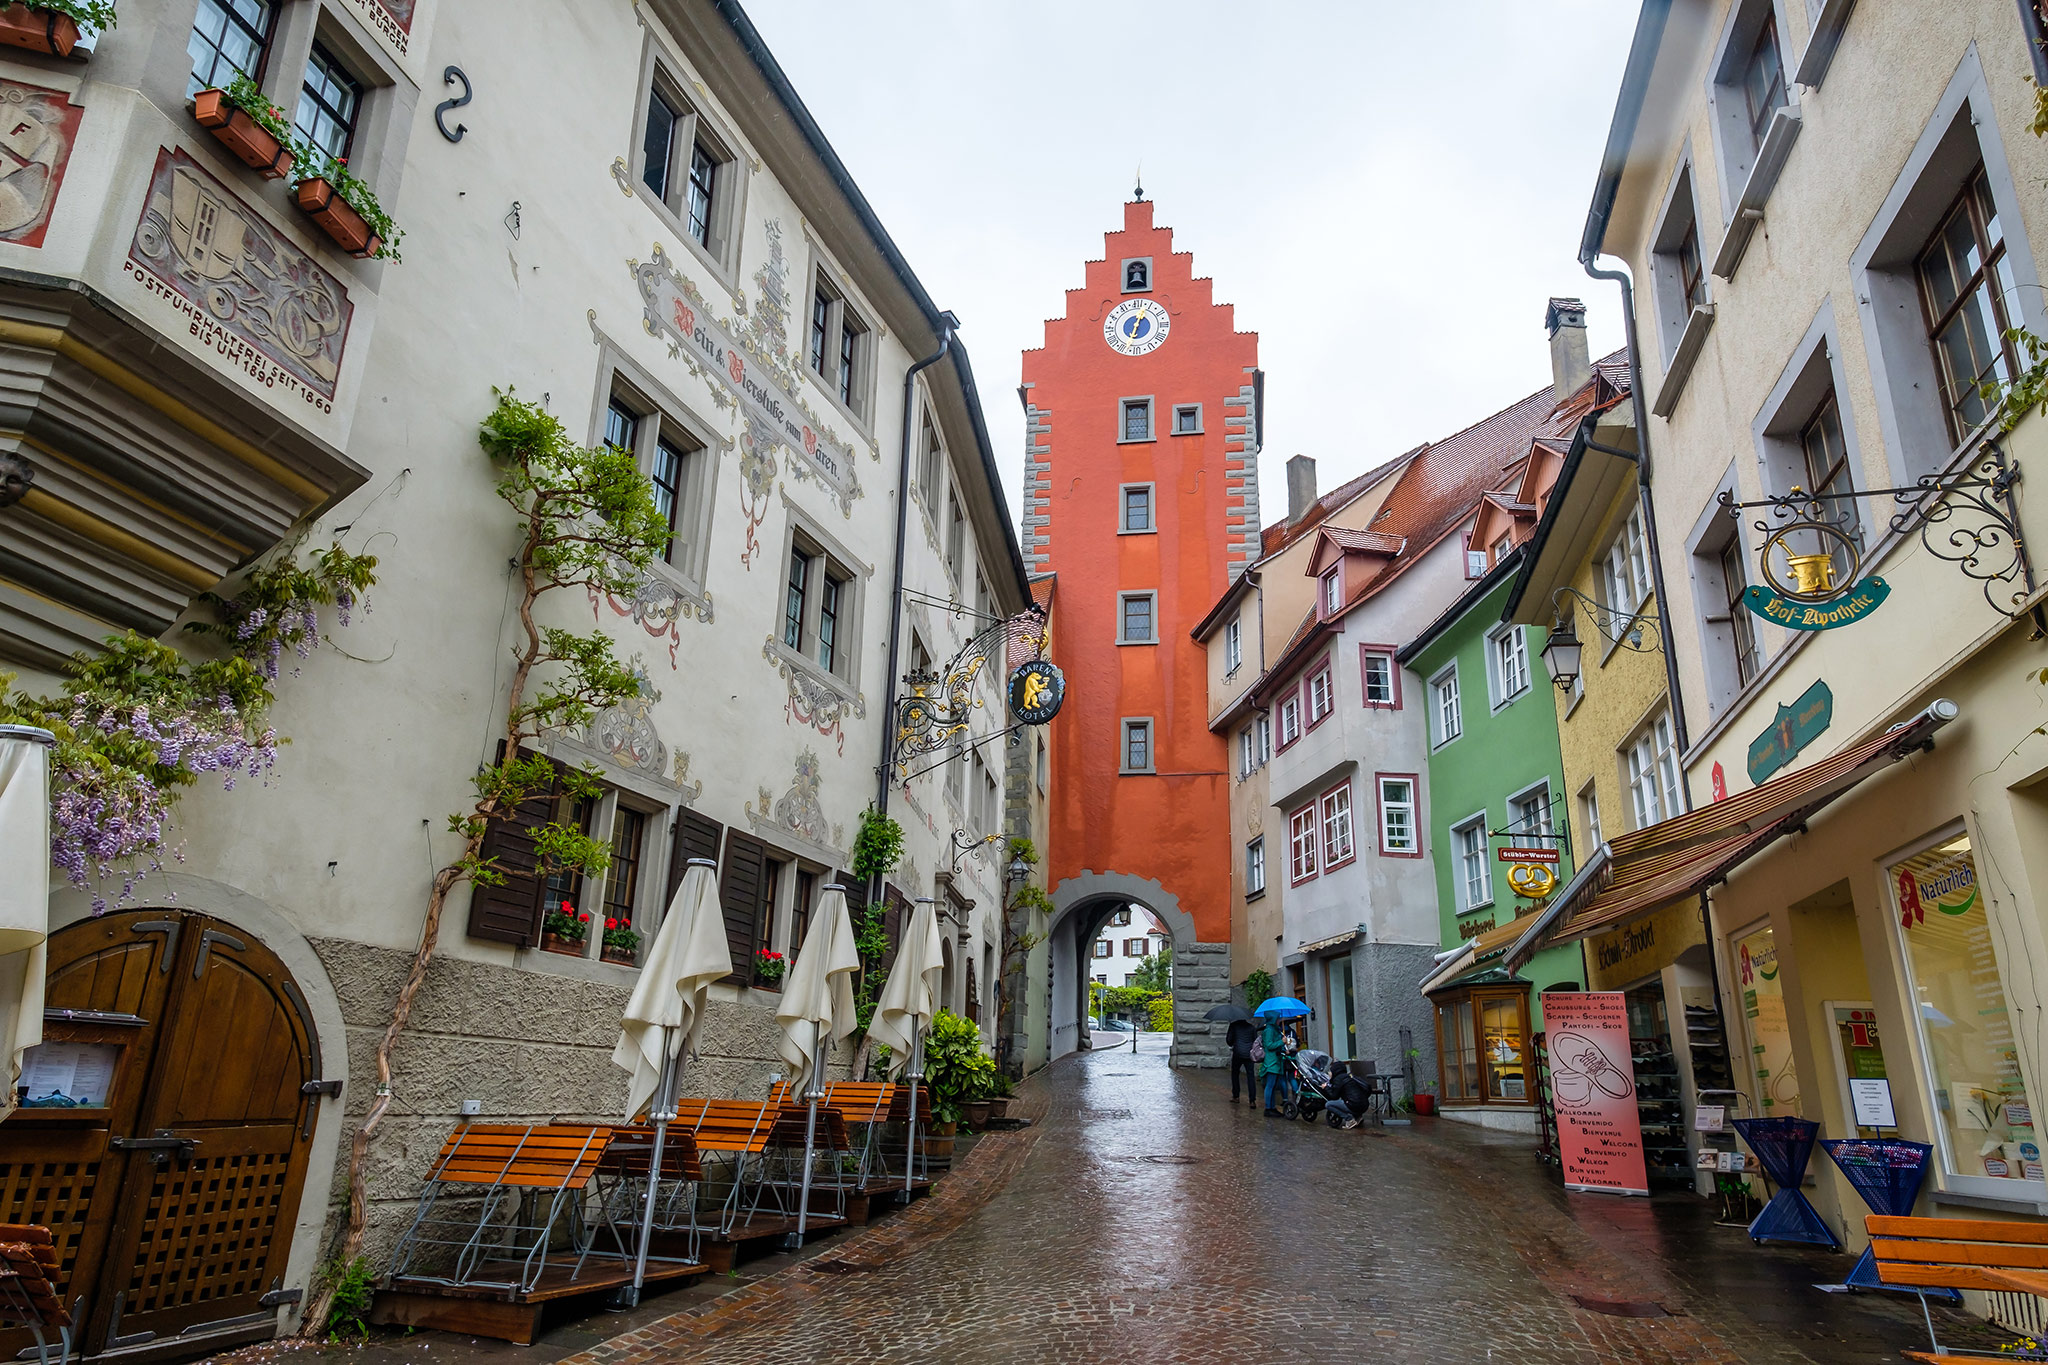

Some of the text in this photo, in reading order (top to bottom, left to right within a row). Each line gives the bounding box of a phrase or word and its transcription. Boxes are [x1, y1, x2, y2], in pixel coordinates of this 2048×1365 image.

[123, 261, 332, 415] POSTFUHRHALTEREI SEIT 1860
[189, 322, 274, 389] BIS UM 1890
[727, 350, 785, 424] Bierstube
[785, 417, 802, 443] zum
[1763, 594, 1874, 626] Hof-Apotheke
[1017, 706, 1053, 720] HOTEL
[1920, 863, 1974, 902] Natürlich
[1751, 946, 1777, 969] Natürlich
[1585, 993, 1620, 1001] ZAPATOS
[1555, 1108, 1602, 1116] WILLKOMMEN
[1569, 1117, 1613, 1127] BIENVENIDO
[1582, 1127, 1622, 1137] BIENVENUE
[1599, 1138, 1638, 1148] WELCOME
[1583, 1147, 1627, 1157] BENVENUTO
[1576, 1156, 1609, 1165] WELKOM
